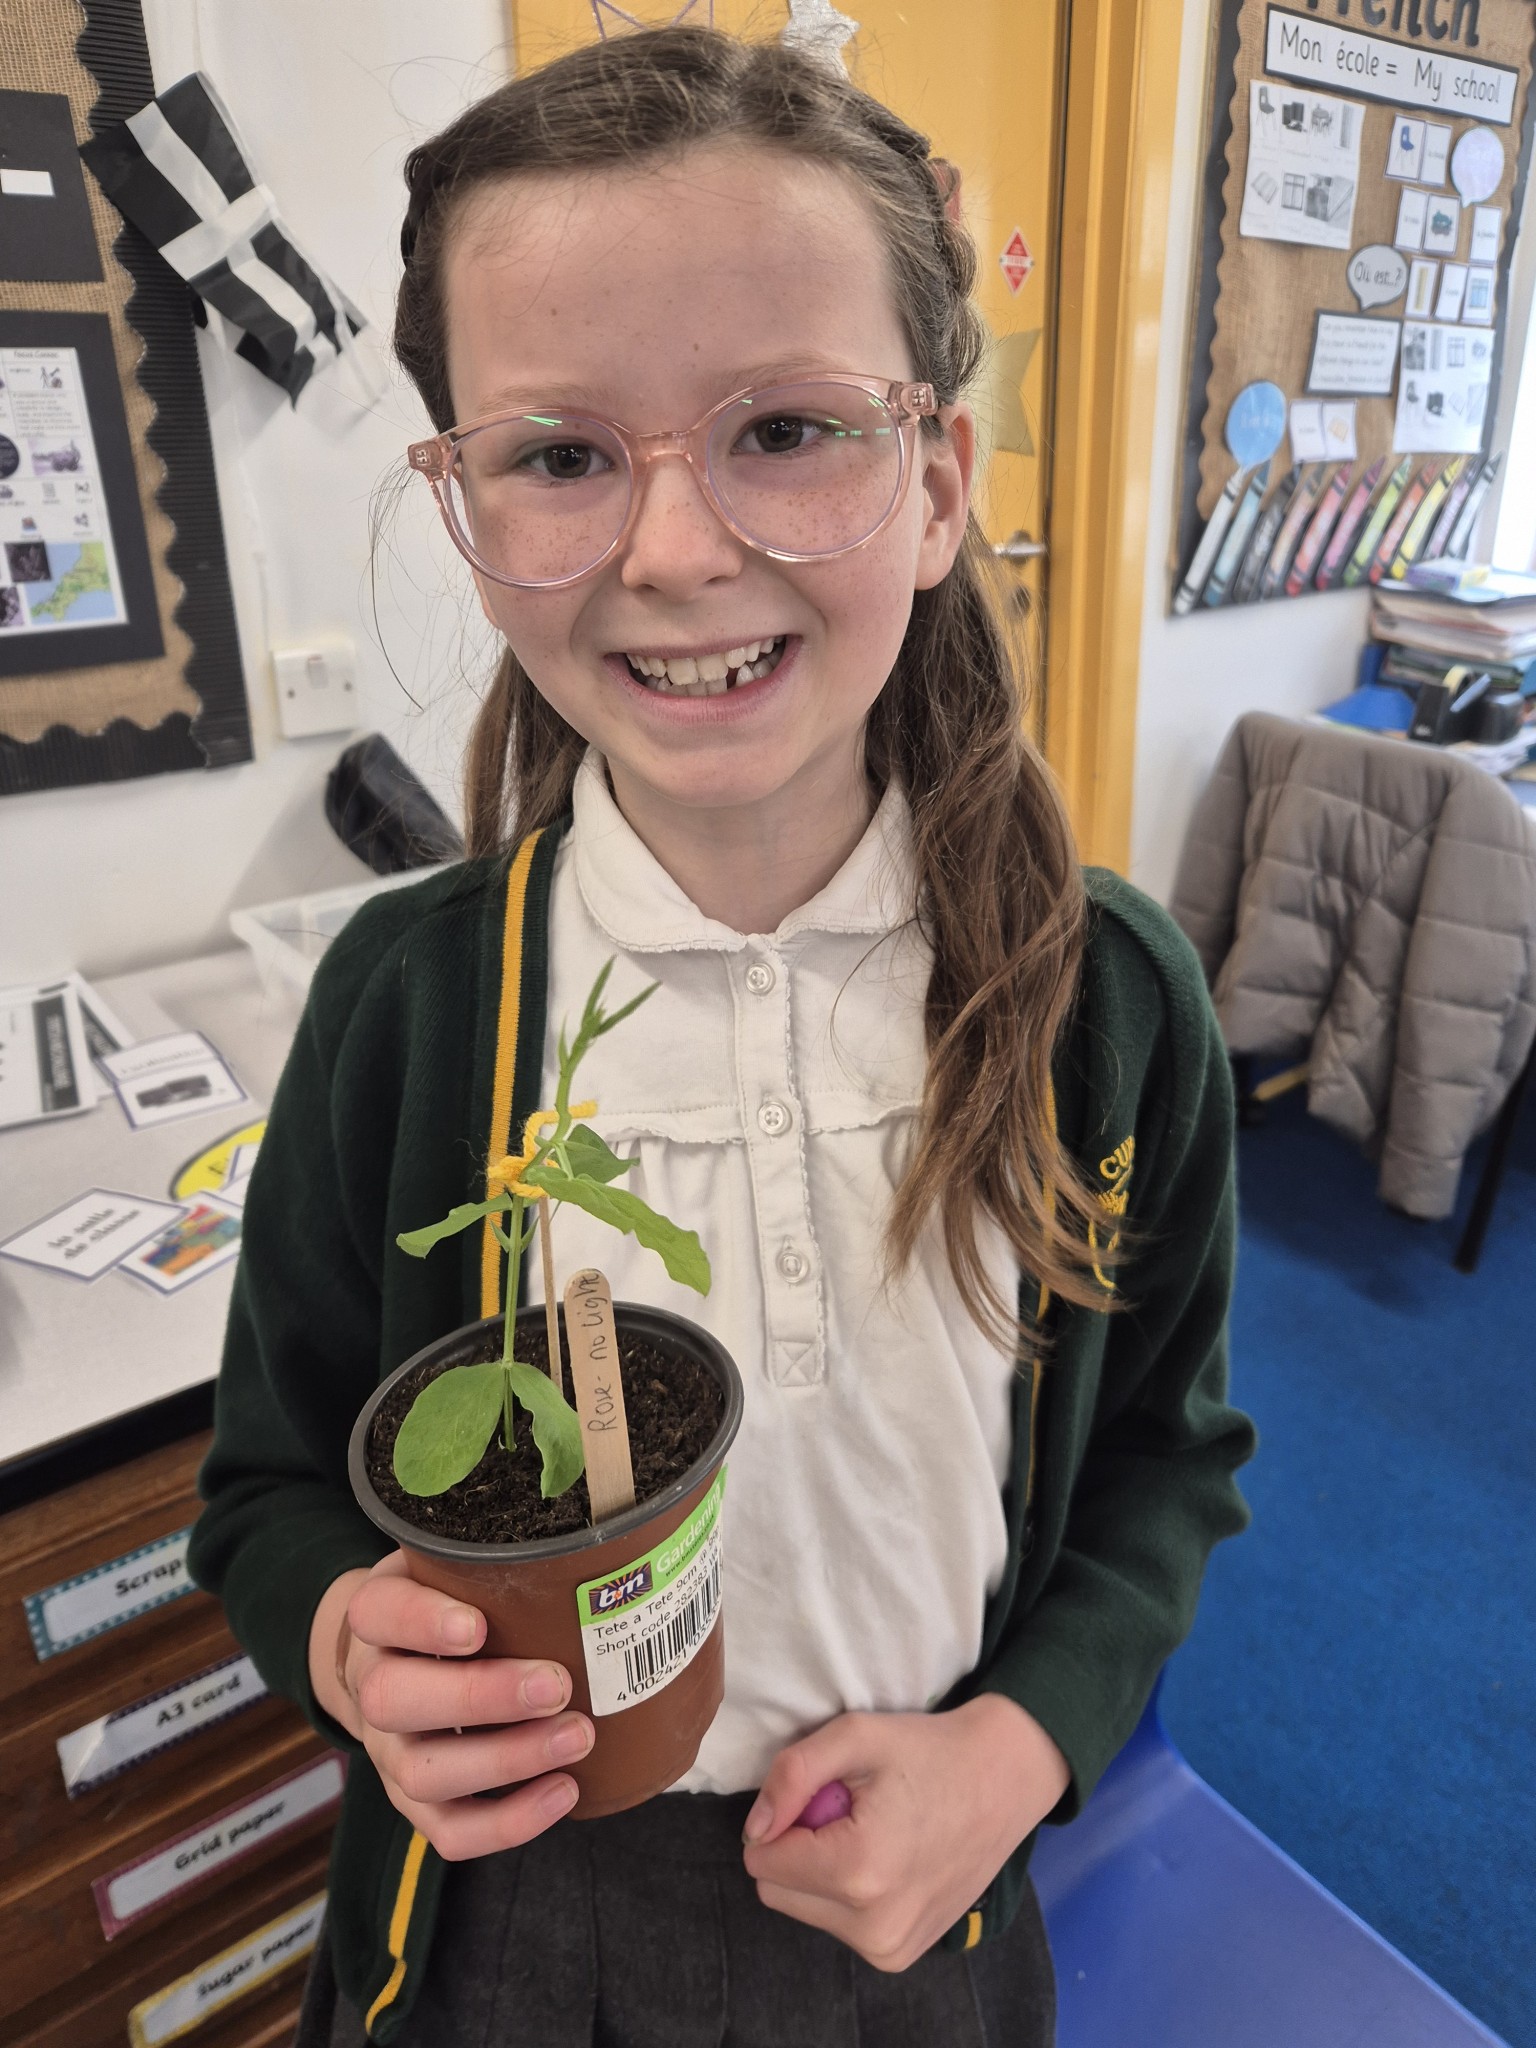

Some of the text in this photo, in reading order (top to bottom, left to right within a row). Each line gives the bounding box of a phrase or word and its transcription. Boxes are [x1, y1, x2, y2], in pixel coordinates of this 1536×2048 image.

[1307, 0, 1480, 47] ench
[1280, 21, 1322, 63] Mon
[1336, 40, 1379, 77] école
[1414, 57, 1442, 102] My
[1453, 69, 1501, 103] school
[589, 1334, 607, 1361] no
[656, 1481, 721, 1573] Gardening
[115, 1558, 182, 1597] Scrap
[593, 1621, 628, 1639] Tete
[633, 1614, 642, 1624] a
[645, 1591, 674, 1615] Tete
[676, 1565, 698, 1591] 9cm
[596, 1633, 637, 1655] Short
[641, 1611, 671, 1637] code
[634, 1648, 687, 1695] 002421
[156, 1672, 242, 1727] A3 card
[174, 1801, 286, 1870] Grid paper
[197, 1917, 315, 1997] Sugar paper
